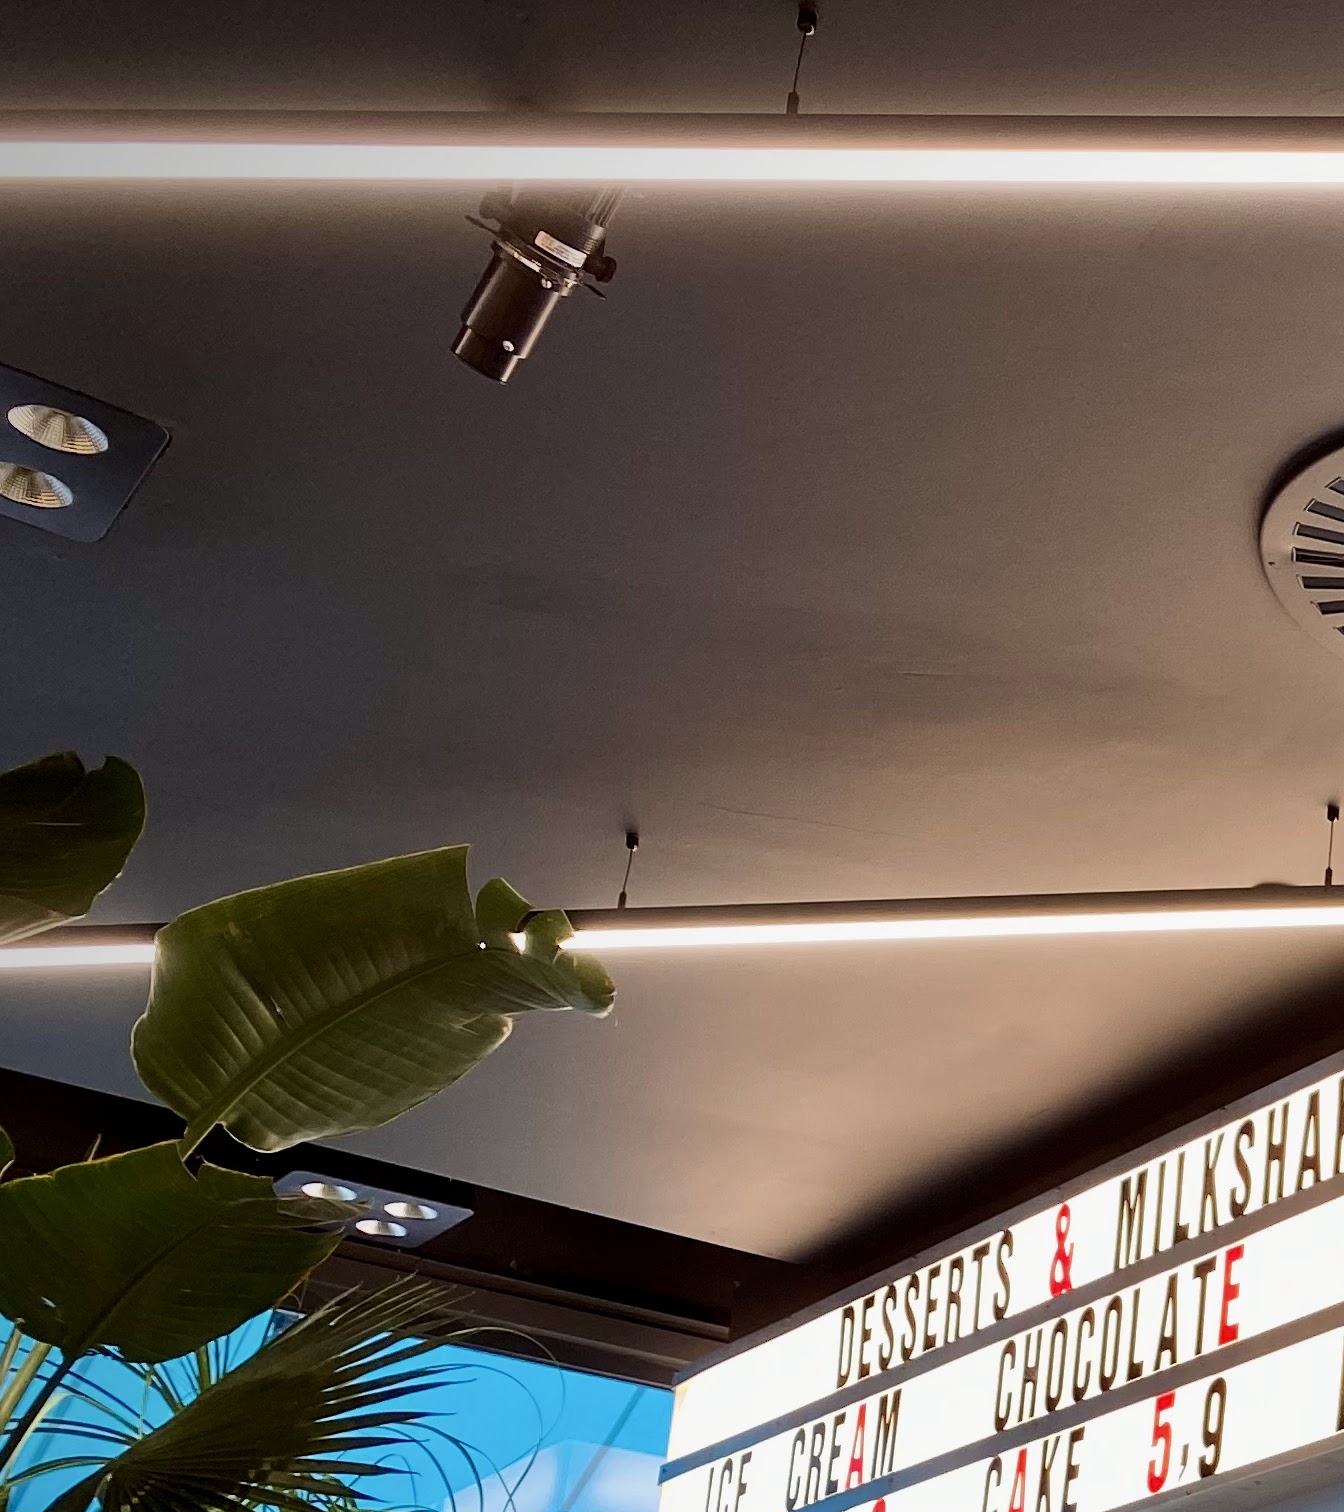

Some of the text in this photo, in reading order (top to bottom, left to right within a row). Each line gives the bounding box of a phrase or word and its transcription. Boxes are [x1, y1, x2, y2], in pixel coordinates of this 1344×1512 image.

[836, 1229, 1016, 1390] DESSERTS
[1049, 1203, 1074, 1298] &
[992, 1244, 1246, 1434] CHOCOLATE
[1146, 1376, 1228, 1495] 5,9
